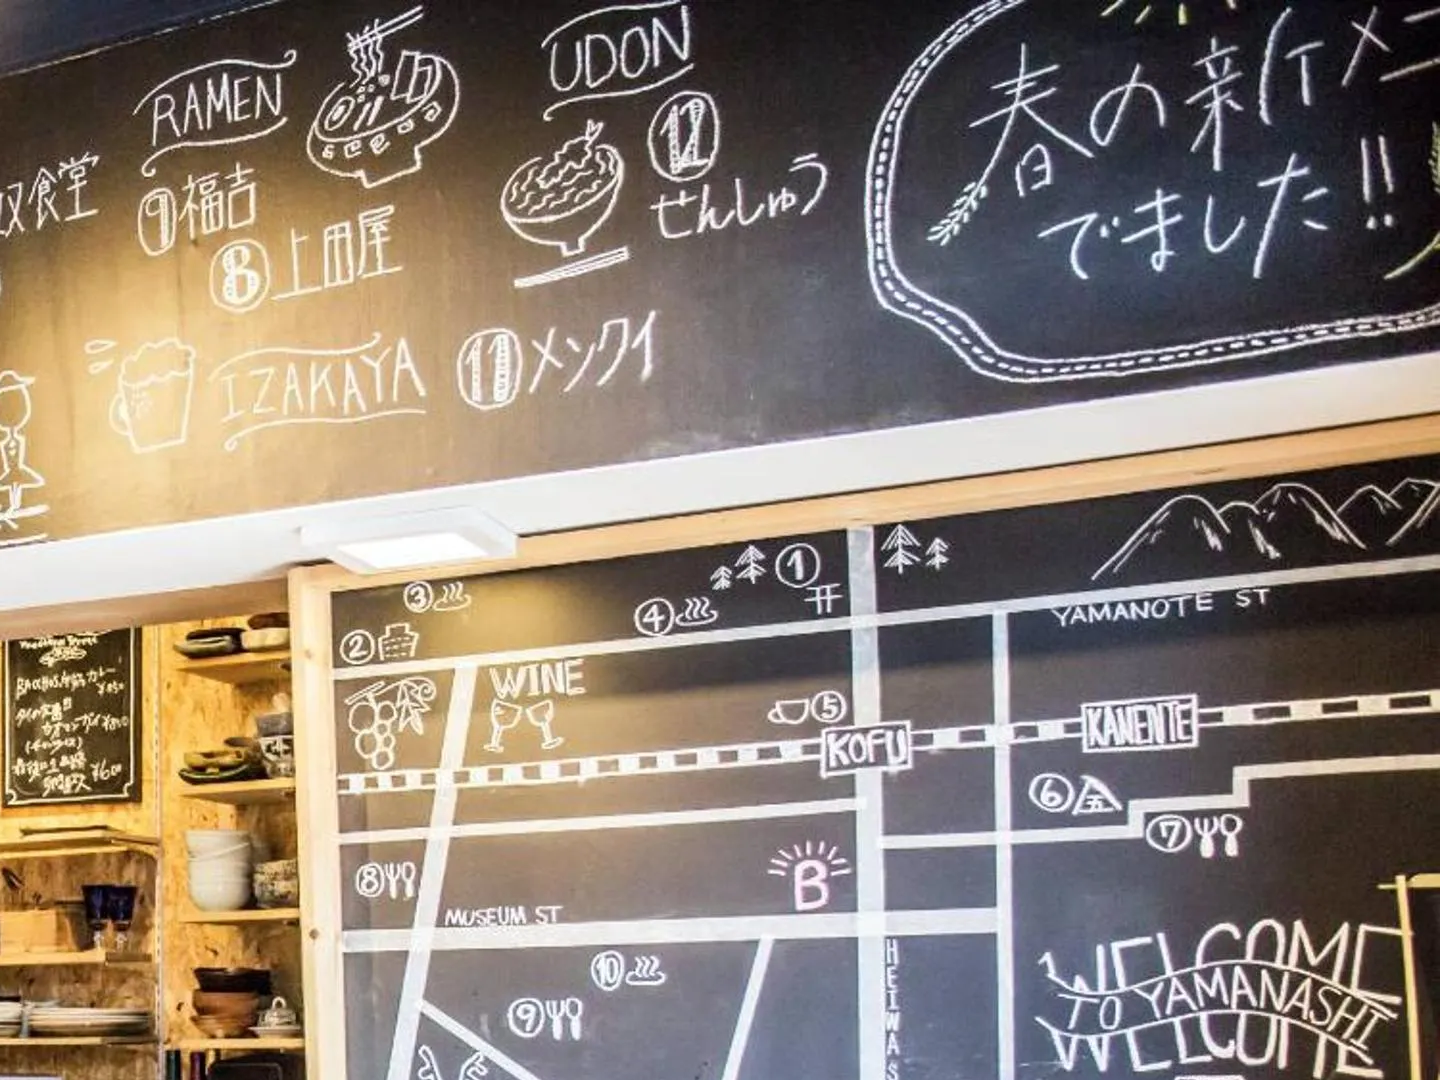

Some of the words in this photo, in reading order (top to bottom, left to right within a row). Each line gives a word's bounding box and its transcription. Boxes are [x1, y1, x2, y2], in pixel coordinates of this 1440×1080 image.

[550, 4, 690, 91] UDON
[151, 72, 284, 146] RAMEN
[220, 337, 427, 423] IZAKAYA
[1050, 592, 1215, 628] YAMANOTE
[1234, 588, 1272, 608] ST
[489, 658, 588, 699] WINE
[826, 728, 907, 770] KOFU
[444, 905, 527, 927] MUSEUM
[535, 904, 563, 925] ST
[1057, 993, 1123, 1031] TO
[1133, 965, 1391, 1051] YAMANASHI
